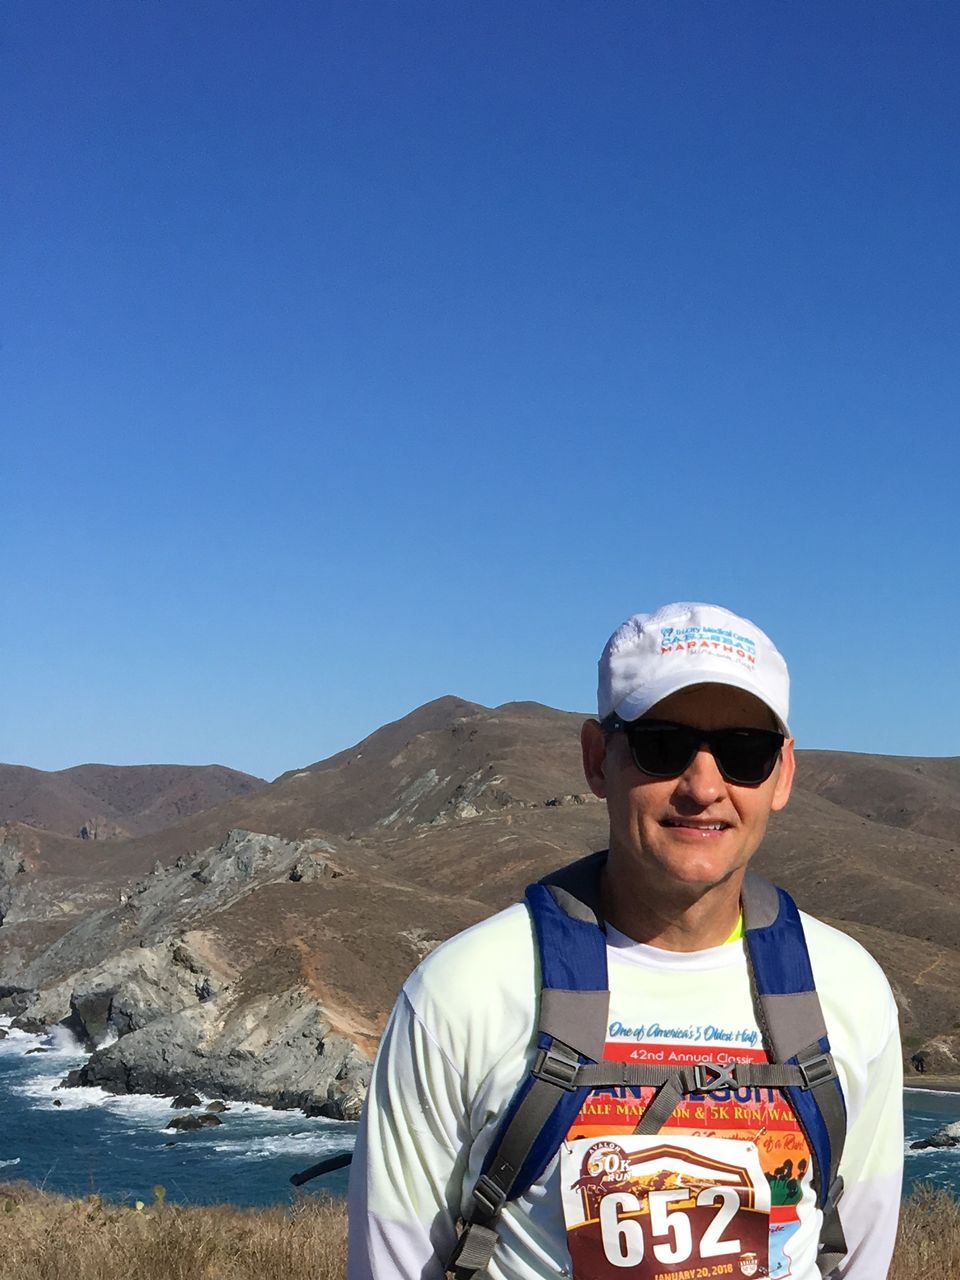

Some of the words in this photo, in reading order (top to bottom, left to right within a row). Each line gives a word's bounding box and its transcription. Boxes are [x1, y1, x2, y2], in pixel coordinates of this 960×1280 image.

[661, 640, 756, 664] MARATHON
[609, 1021, 633, 1038] One
[634, 1024, 645, 1041] of
[646, 1023, 694, 1040] America's
[703, 1025, 734, 1042] Oldest
[735, 1029, 759, 1047] Half
[630, 1049, 664, 1060] 42nd
[668, 1051, 713, 1063] Annual
[716, 1052, 755, 1064] Classic
[694, 1107, 705, 1119] &
[710, 1106, 729, 1119] 5K
[589, 1142, 621, 1154] AVALON
[589, 1154, 632, 1177] 50K
[608, 1173, 632, 1182] RUN
[600, 1187, 742, 1268] 652
[696, 1267, 711, 1278] 20,
[712, 1263, 734, 1276] 2018
